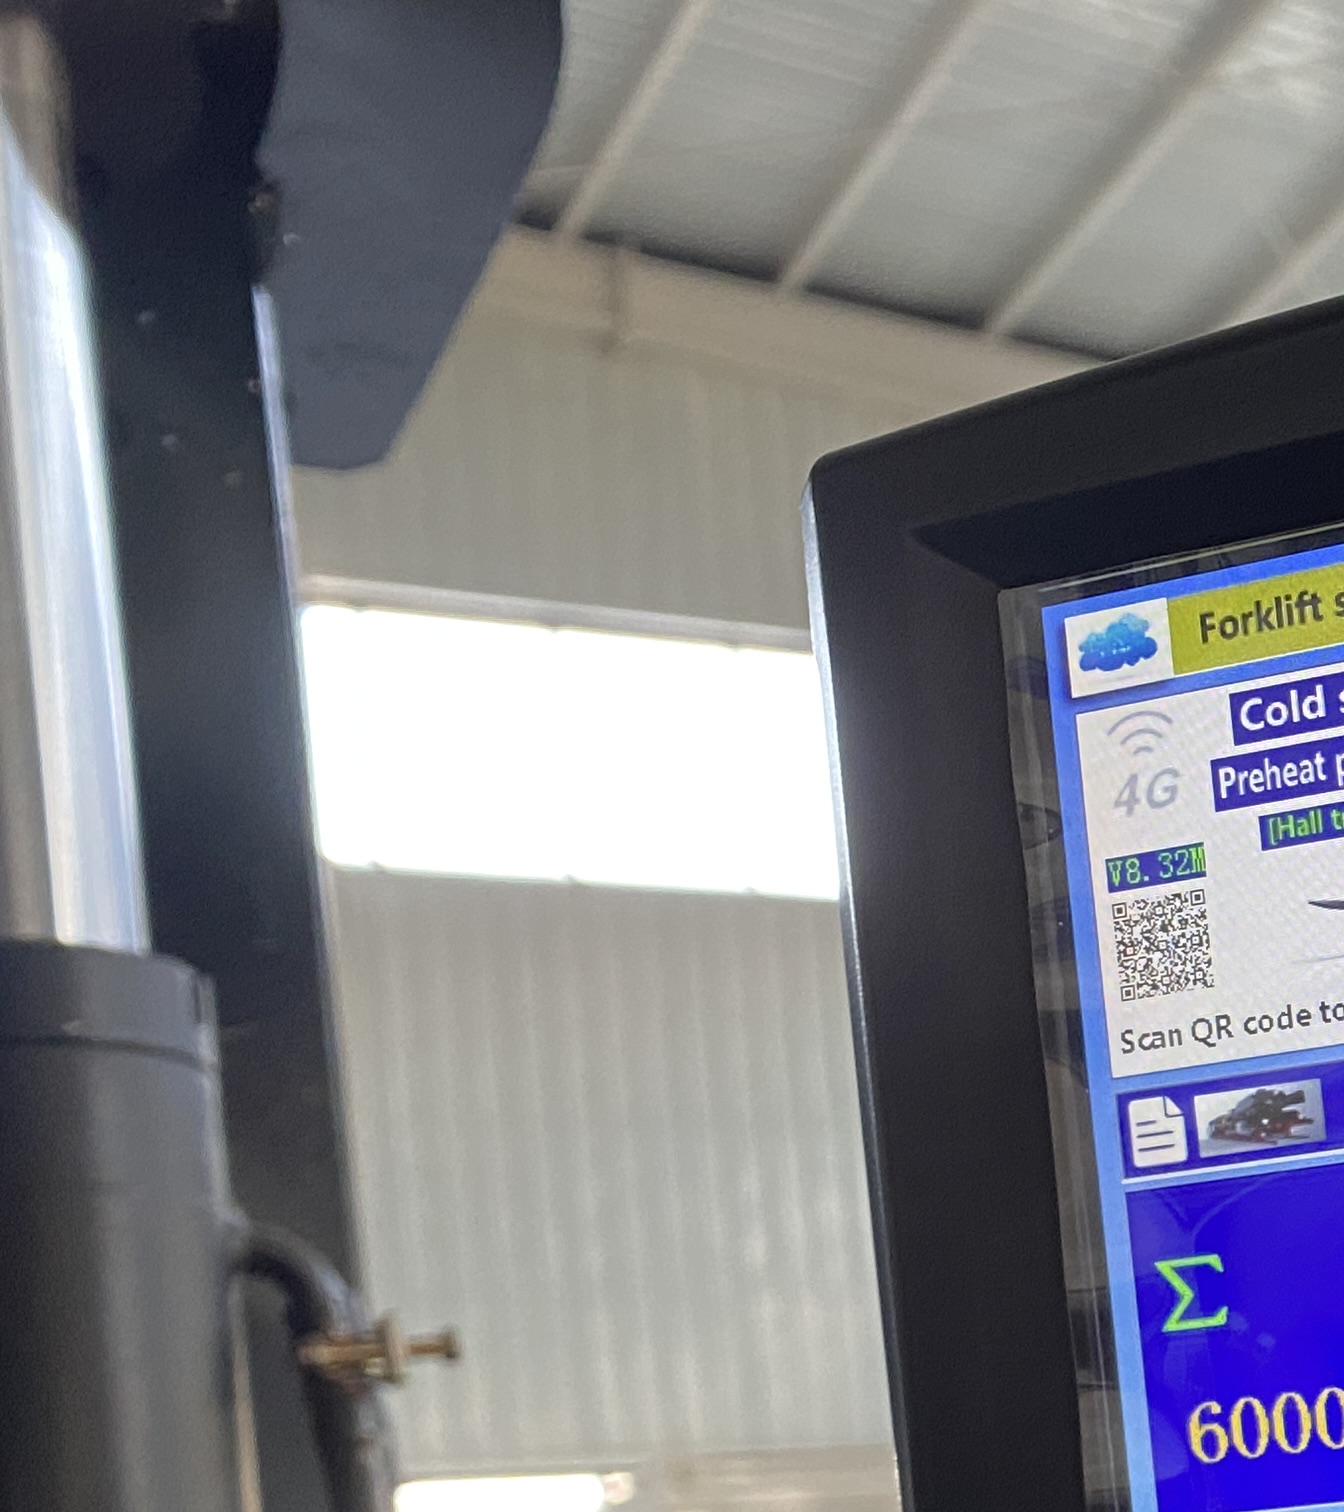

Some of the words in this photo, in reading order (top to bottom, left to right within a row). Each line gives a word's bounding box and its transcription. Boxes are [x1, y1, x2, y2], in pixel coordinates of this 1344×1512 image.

[1199, 589, 1323, 644] Forklift
[1240, 684, 1326, 731] Cold
[1114, 767, 1181, 818] 4G
[1218, 752, 1327, 799] Preheat
[1268, 808, 1324, 846] [Hall
[1120, 1022, 1183, 1056] Scan
[1191, 1013, 1235, 1044] QR
[1242, 1004, 1312, 1036] code
